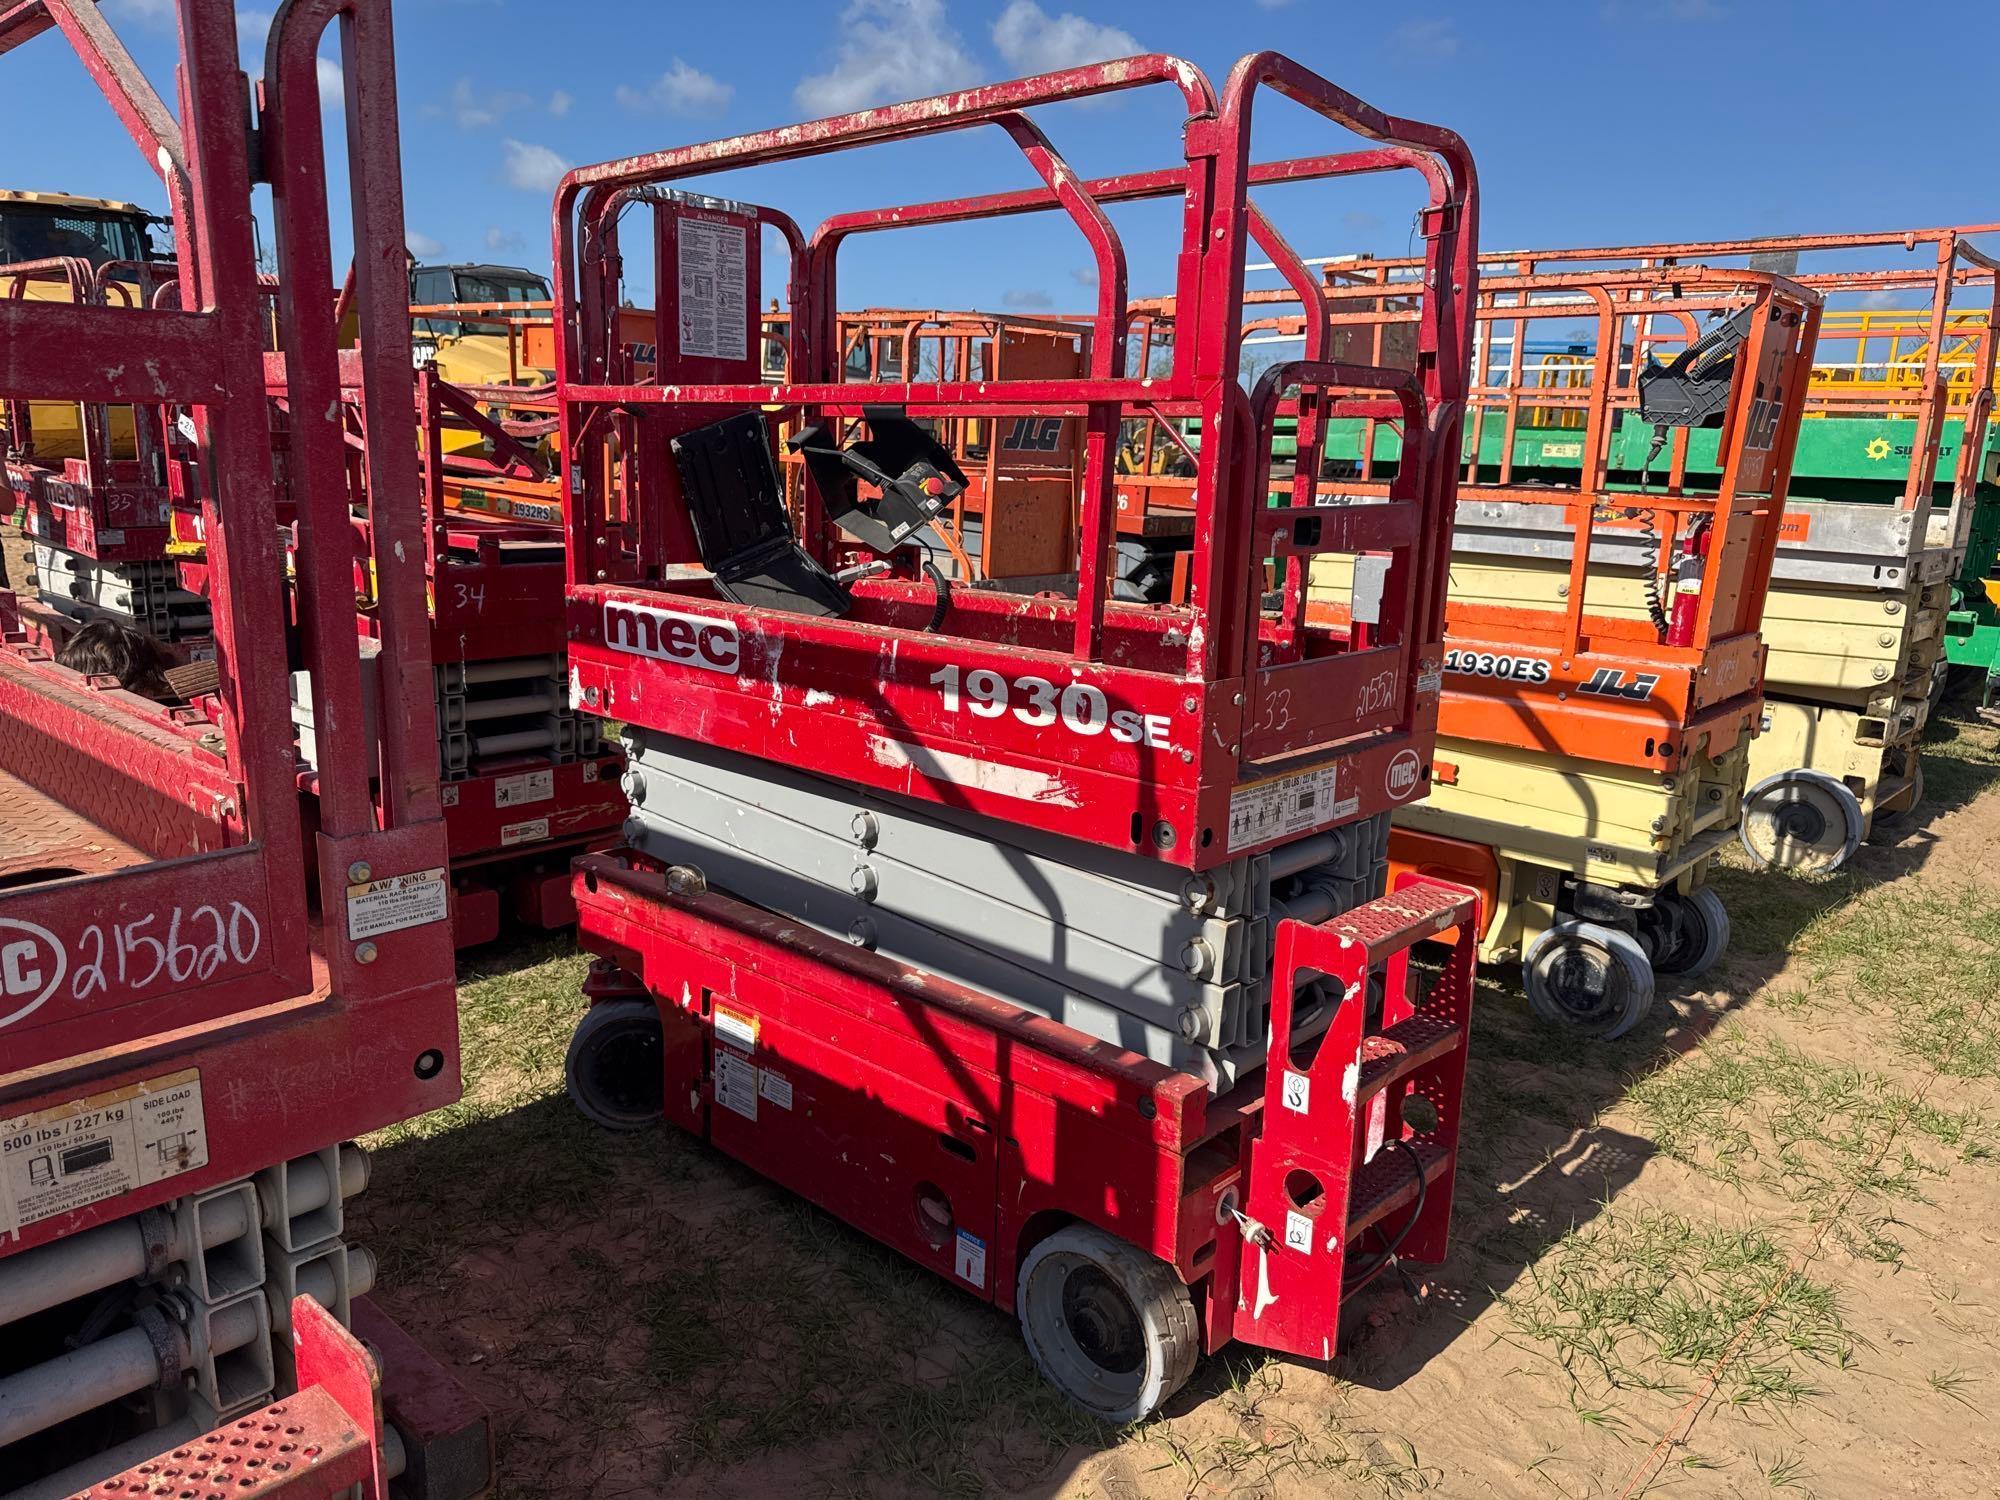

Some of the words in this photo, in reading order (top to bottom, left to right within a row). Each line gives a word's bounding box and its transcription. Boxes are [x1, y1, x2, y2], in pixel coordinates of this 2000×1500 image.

[1002, 418, 1063, 452] JLG
[109, 494, 134, 511] 35
[514, 503, 550, 520] 1932RS
[454, 583, 486, 613] 34
[606, 606, 738, 666] mec
[1444, 650, 1549, 683] 1930ES
[1577, 667, 1660, 701] JLG
[356, 893, 387, 904] MATERIAL
[369, 920, 394, 930] MANUAL
[395, 916, 408, 924] FOR
[72, 901, 260, 999] 215620
[143, 1096, 165, 1110] SIDE
[165, 1089, 191, 1105] LOAD
[157, 1109, 173, 1119] 100
[3, 1134, 32, 1151] 500
[36, 1127, 61, 1142] lbs
[73, 1112, 101, 1131] 227
[105, 1107, 125, 1122] kg
[38, 1145, 52, 1154] 110
[53, 1140, 67, 1150] lbs
[85, 1132, 96, 1141] kg
[19, 1213, 36, 1224] SEE
[37, 1202, 70, 1218] MANUAL
[72, 1196, 89, 1206] FOR
[90, 1188, 110, 1200] SAFE
